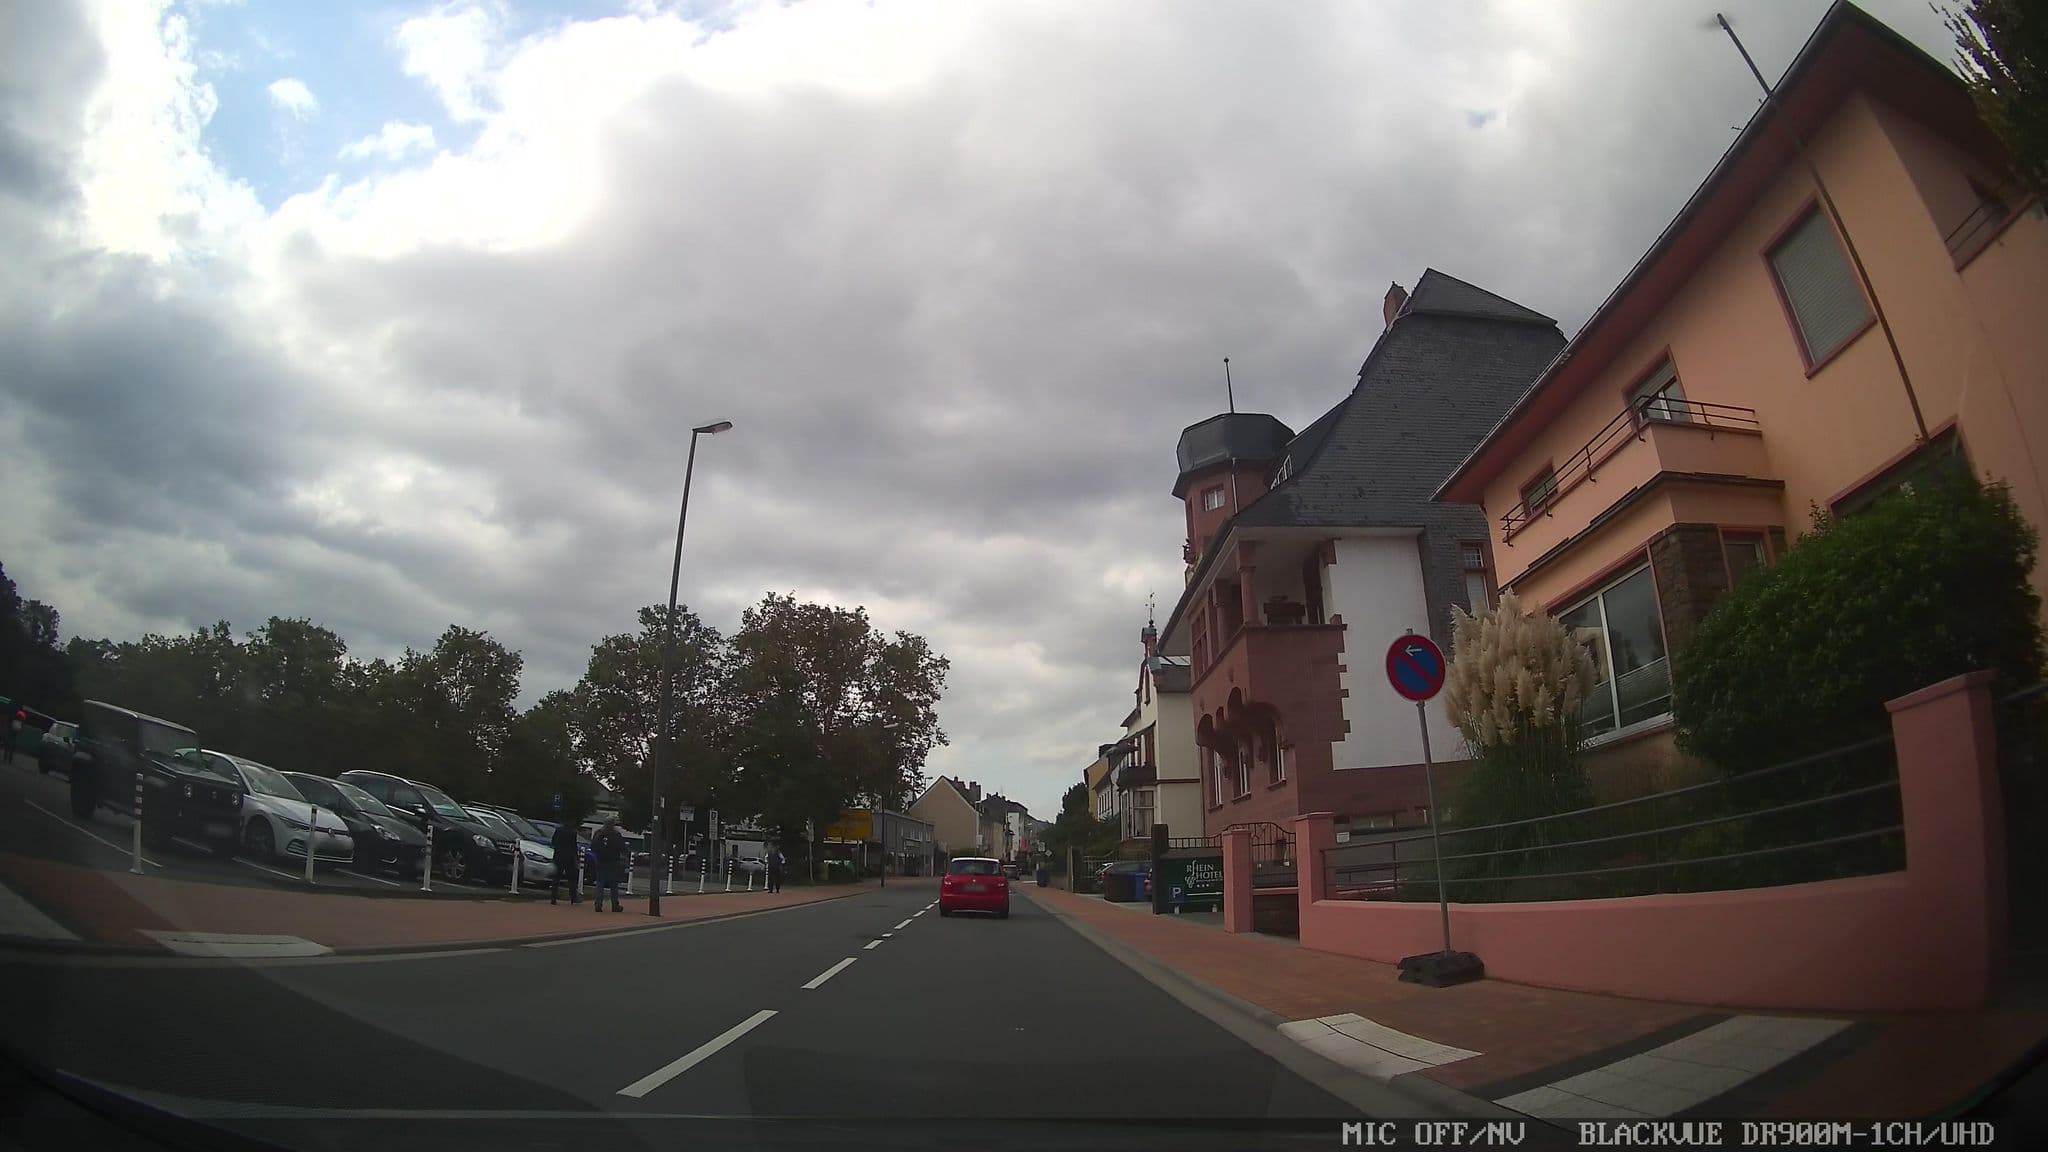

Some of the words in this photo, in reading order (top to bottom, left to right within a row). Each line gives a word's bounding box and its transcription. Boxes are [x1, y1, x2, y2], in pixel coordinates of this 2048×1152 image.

[1186, 860, 1214, 876] RHEIN
[1196, 870, 1223, 879] HOTEL
[1173, 887, 1182, 898] P
